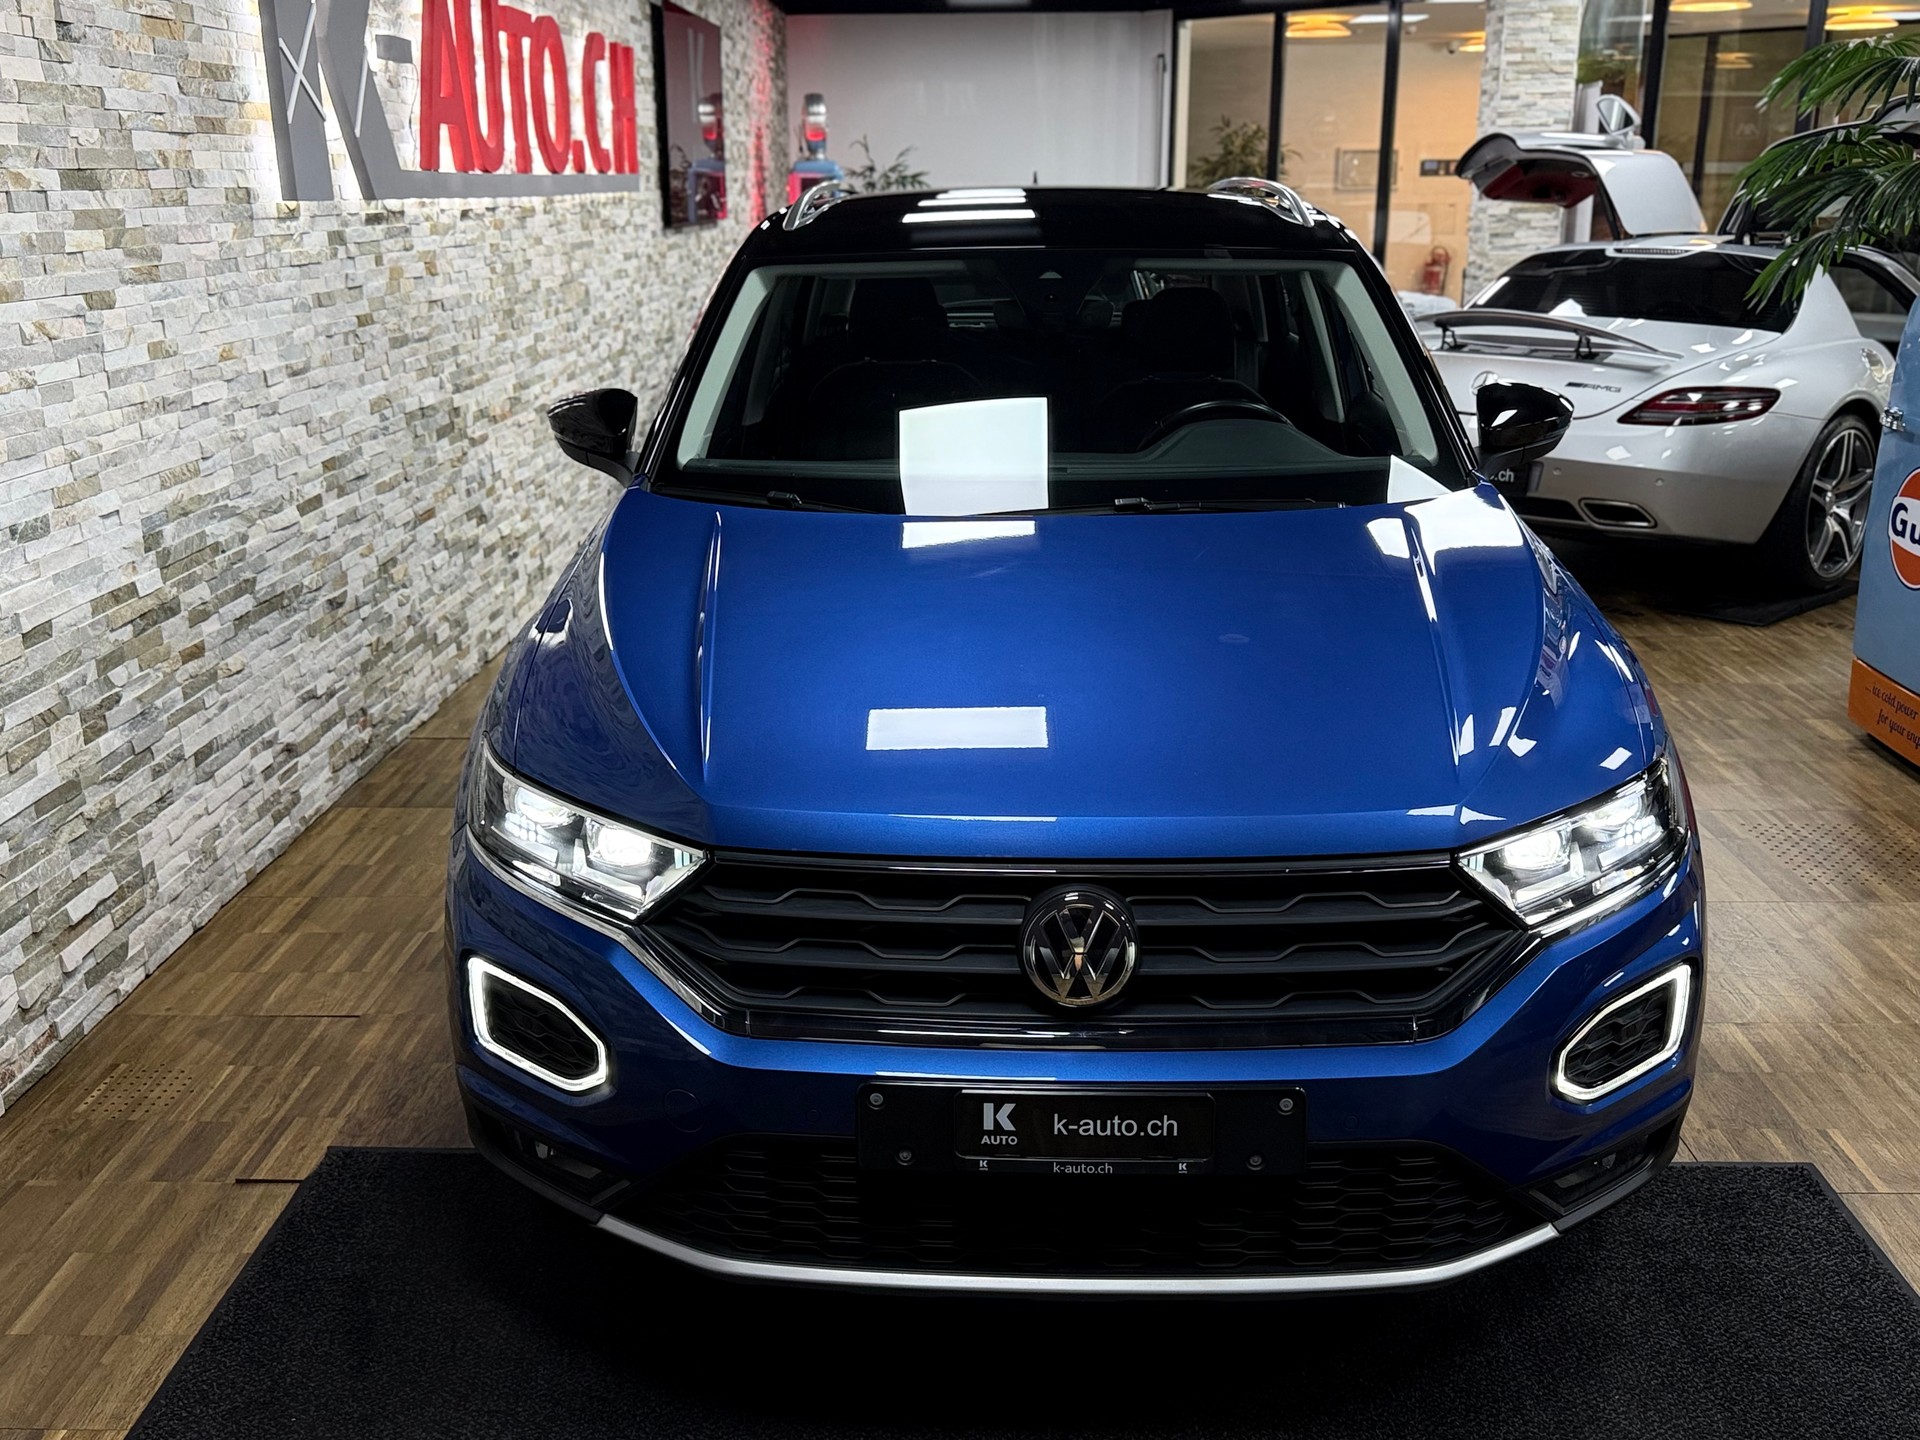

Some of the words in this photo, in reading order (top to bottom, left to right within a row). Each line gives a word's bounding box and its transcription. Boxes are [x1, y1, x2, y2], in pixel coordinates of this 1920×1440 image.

[983, 1102, 1017, 1131] K
[1053, 1113, 1178, 1137] k-auto.ch
[980, 1134, 1018, 1146] AUTO
[1053, 1161, 1113, 1174] k-auto.ch
